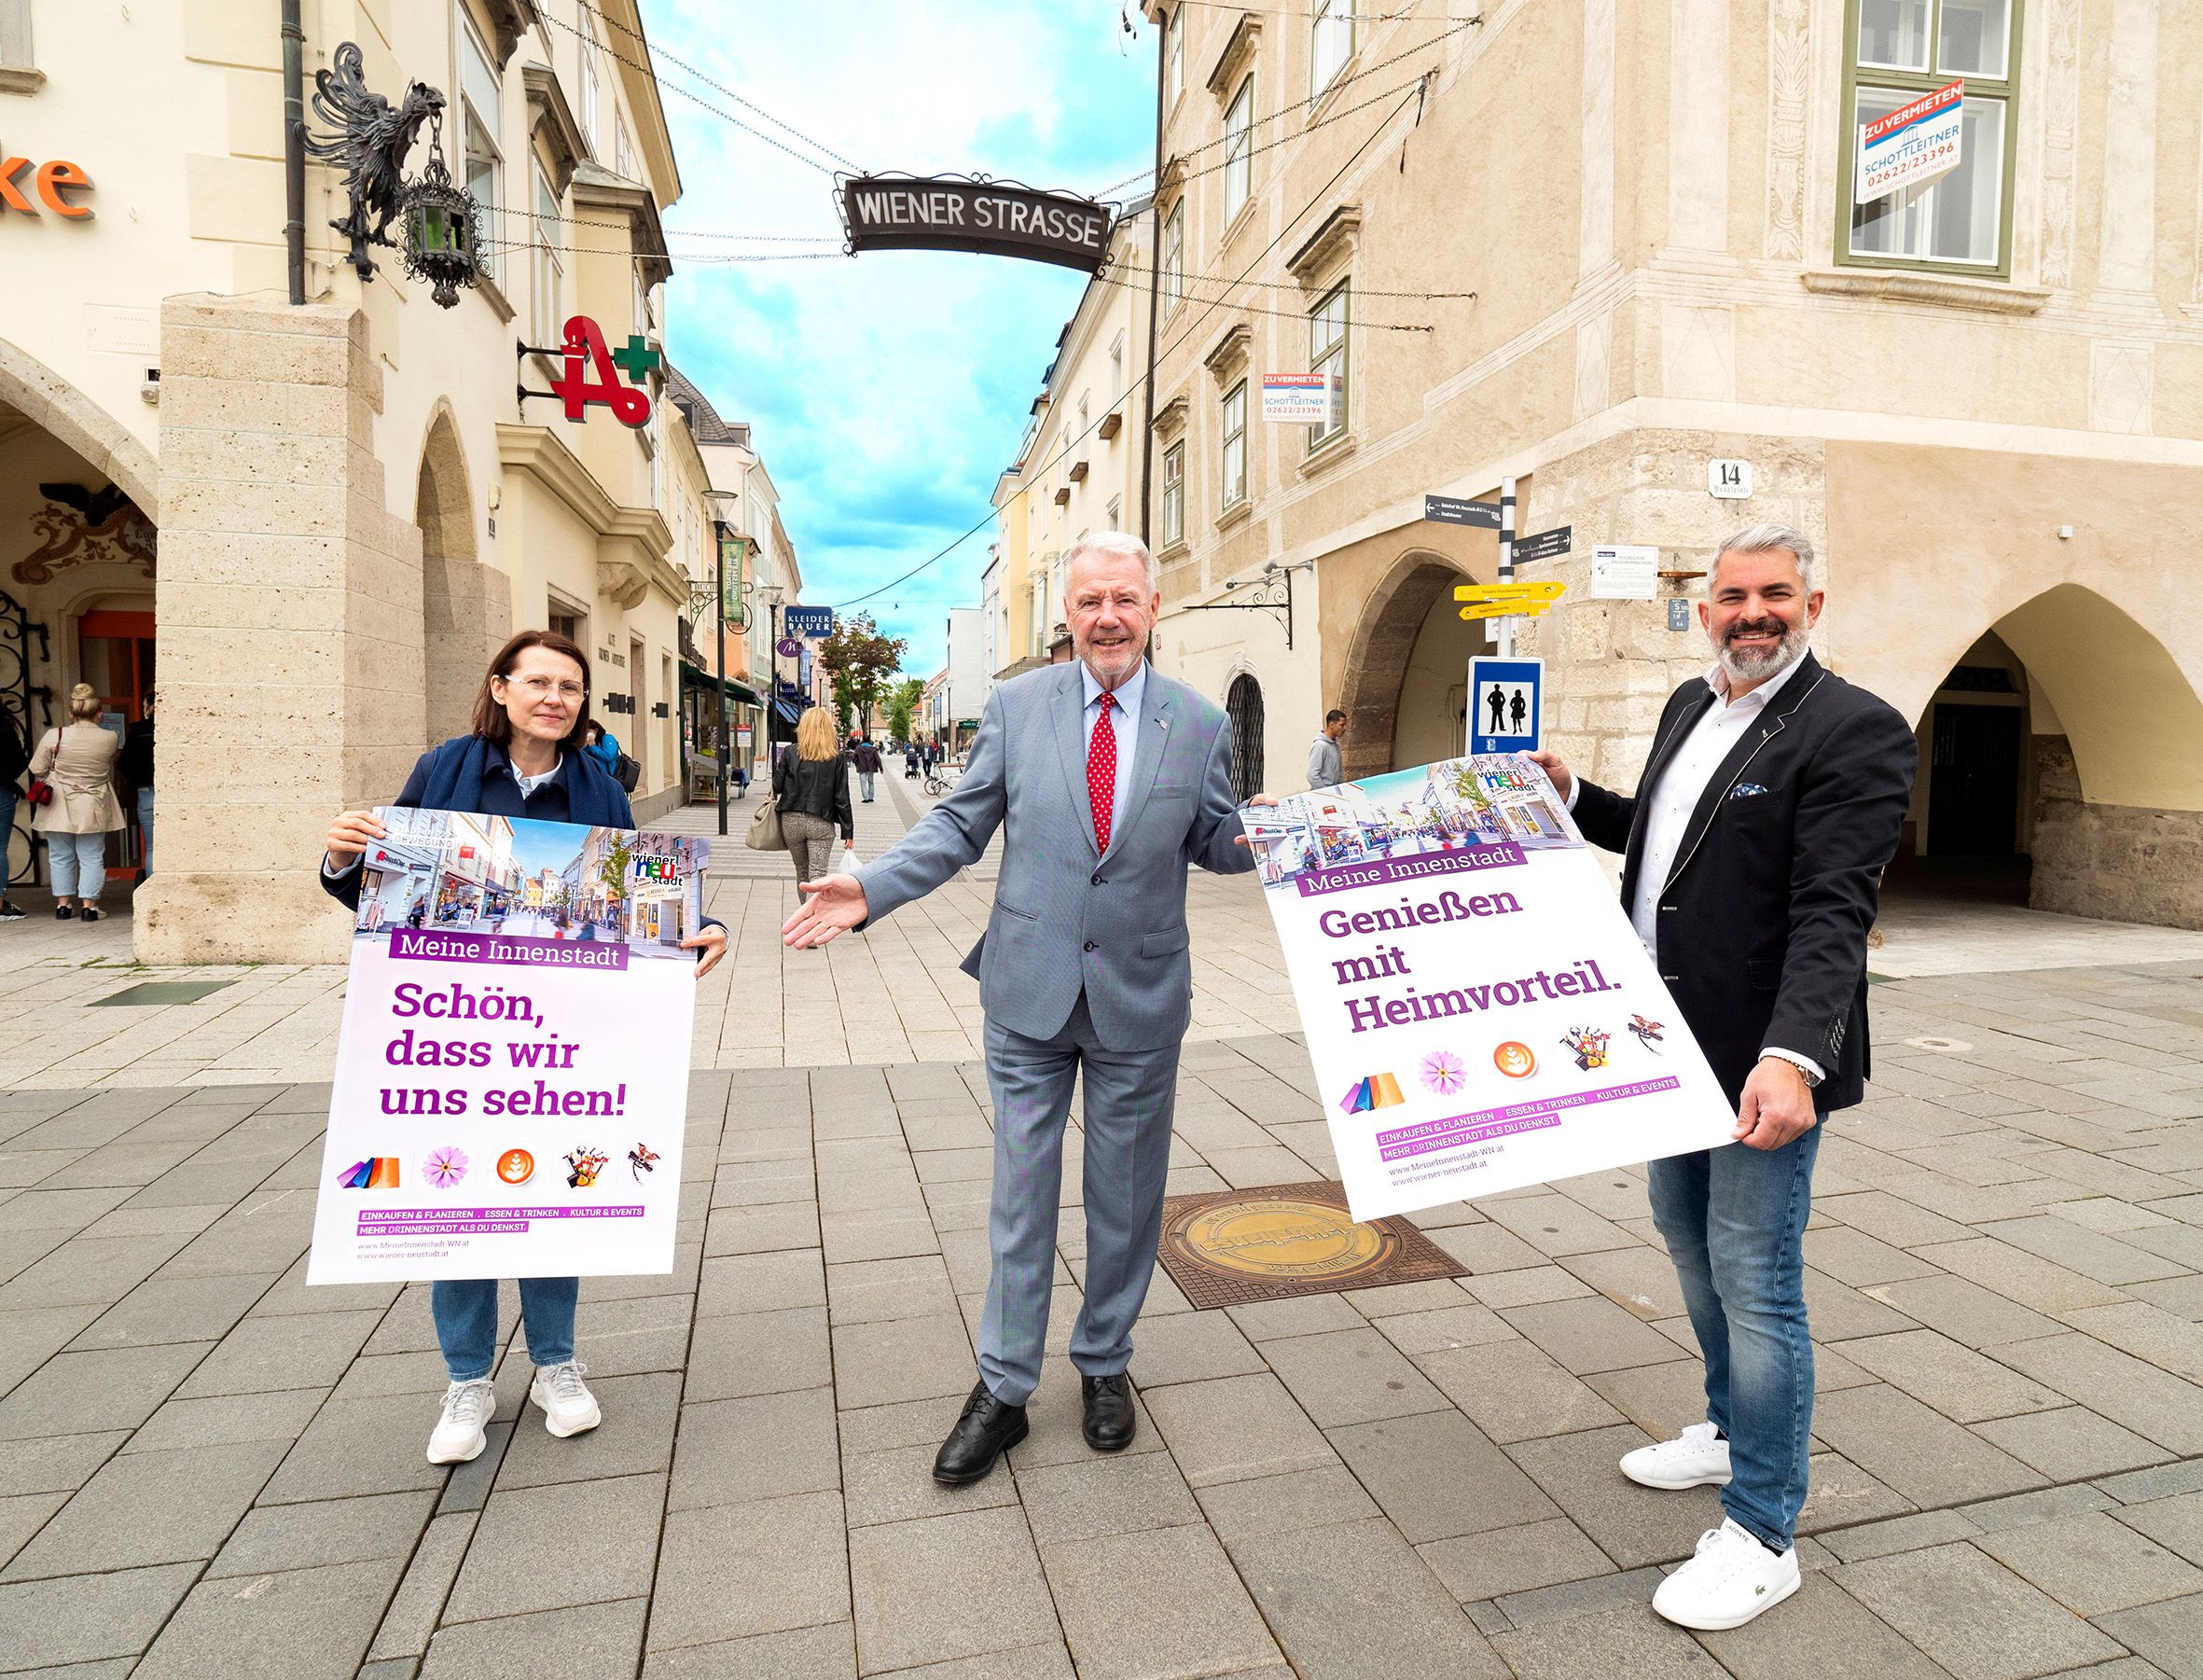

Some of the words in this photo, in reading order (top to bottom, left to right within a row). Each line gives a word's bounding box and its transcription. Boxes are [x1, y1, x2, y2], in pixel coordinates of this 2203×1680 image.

[1865, 124, 1883, 139] ZU
[1885, 84, 1962, 129] VERMIETEN
[1864, 125, 1960, 175] SCHOTTLEITNER
[1868, 142, 1954, 187] 02622/23396
[854, 192, 964, 226] WIENER
[973, 197, 1102, 248] STRASSE
[1721, 464, 1740, 485] 14
[788, 615, 830, 623] KLEIDER
[1477, 769, 1517, 778] wiener
[1484, 774, 1525, 788] neu
[632, 853, 675, 865] wiener
[635, 861, 676, 879] neu
[1305, 868, 1381, 894] Meine
[1386, 847, 1517, 879] Innenstadt
[652, 876, 684, 886] stadt
[1319, 891, 1523, 938] Genießen
[399, 934, 480, 959] Meine
[487, 940, 619, 966] Innenstadt
[1332, 945, 1411, 985] mit
[392, 982, 544, 1029] Schön,
[1344, 960, 1622, 1034] Heimvorteil.
[385, 1029, 492, 1067] dass
[506, 1034, 579, 1069] wir
[380, 1088, 467, 1116] uns
[483, 1080, 626, 1117] sehen!
[1379, 1125, 1433, 1144] EINKAUFEN
[1434, 1123, 1442, 1132] &
[1444, 1112, 1494, 1130] FLANIEREN
[1505, 1104, 1535, 1117] ESSEN
[1536, 1104, 1545, 1112] &
[1545, 1095, 1586, 1110] TRINKEN
[1596, 1087, 1631, 1101] KULTUR
[1632, 1086, 1640, 1094] &
[1641, 1078, 1677, 1092] EVENTS
[1383, 1145, 1411, 1159] MEHR
[1412, 1130, 1484, 1153] DRINNENSTADT
[1486, 1126, 1503, 1137] ALS
[1504, 1124, 1517, 1133] DU
[1519, 1116, 1559, 1131] DENKST.
[1389, 1145, 1504, 1175] www.MeineInnenstadt-WN.at
[1392, 1160, 1488, 1187] www.wiener-neustadt.at
[359, 1226, 386, 1234] MEHR
[388, 1224, 458, 1234] DRINNENSTADT
[459, 1224, 475, 1232] ALS
[492, 1223, 526, 1231] DENKST.
[361, 1212, 414, 1220] EINKAUFEN
[415, 1211, 423, 1219] &
[424, 1211, 474, 1219] FLANIEREN
[484, 1210, 512, 1218] ESSEN
[522, 1209, 560, 1217] TRINKEN
[570, 1208, 602, 1216] KULTUR
[603, 1208, 609, 1216] &
[356, 1250, 449, 1259] www.wiener-neustadt.at
[358, 1240, 469, 1250] www.MeineInnenstadt-WN.at
[1725, 1523, 1749, 1543] LACOSTE
